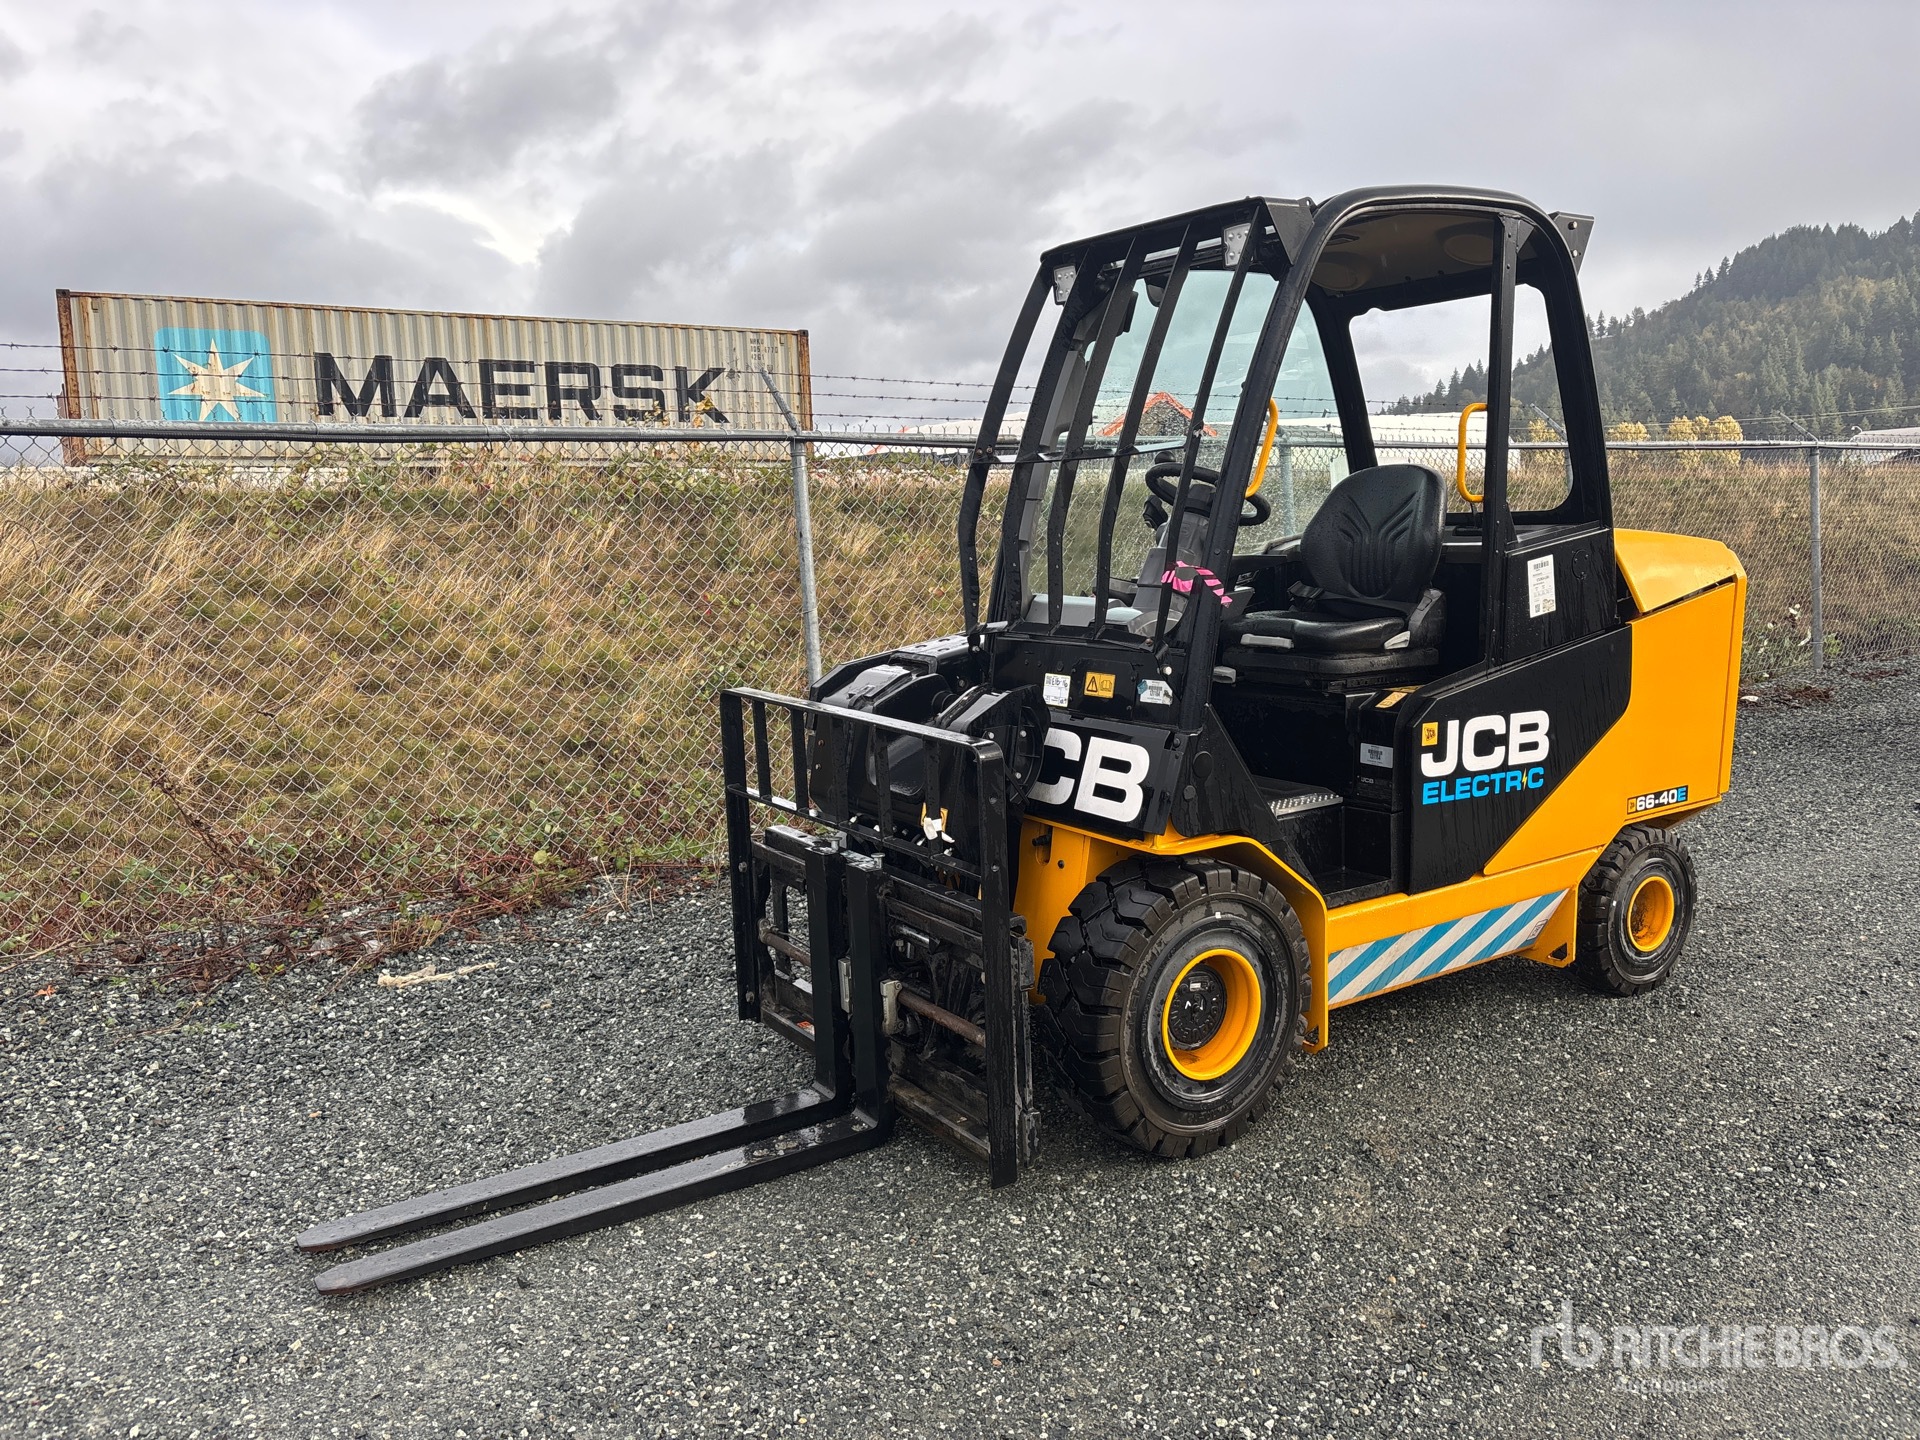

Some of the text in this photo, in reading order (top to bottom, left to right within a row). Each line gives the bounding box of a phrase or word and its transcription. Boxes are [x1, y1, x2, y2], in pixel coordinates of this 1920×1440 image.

[313, 352, 731, 424] MAERSK
[1028, 727, 1151, 822] CB
[1421, 710, 1549, 777] JCB
[1422, 767, 1545, 805] ELECTRIC
